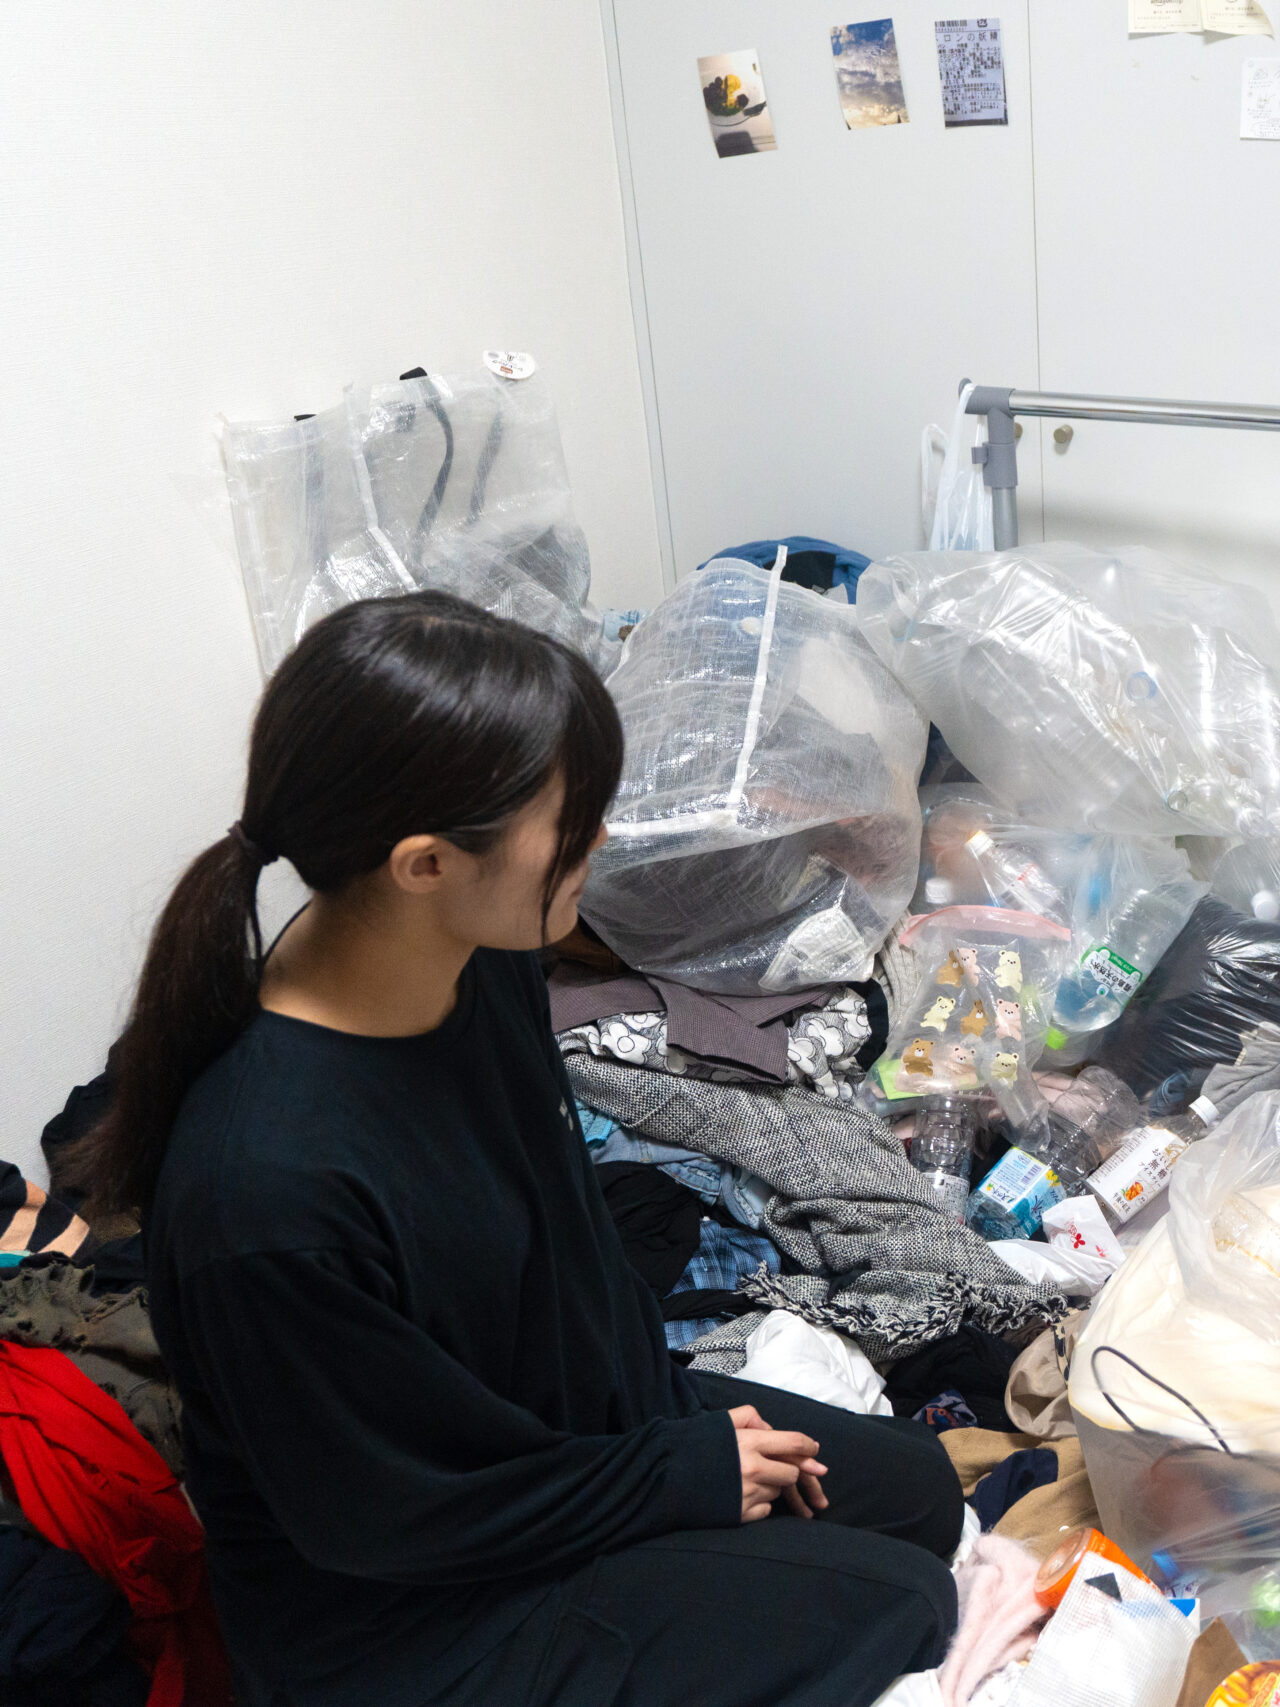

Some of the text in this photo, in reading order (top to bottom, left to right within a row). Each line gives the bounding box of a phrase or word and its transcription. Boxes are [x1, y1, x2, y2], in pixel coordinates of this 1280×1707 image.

[936, 31, 998, 42] ロンの妖精
